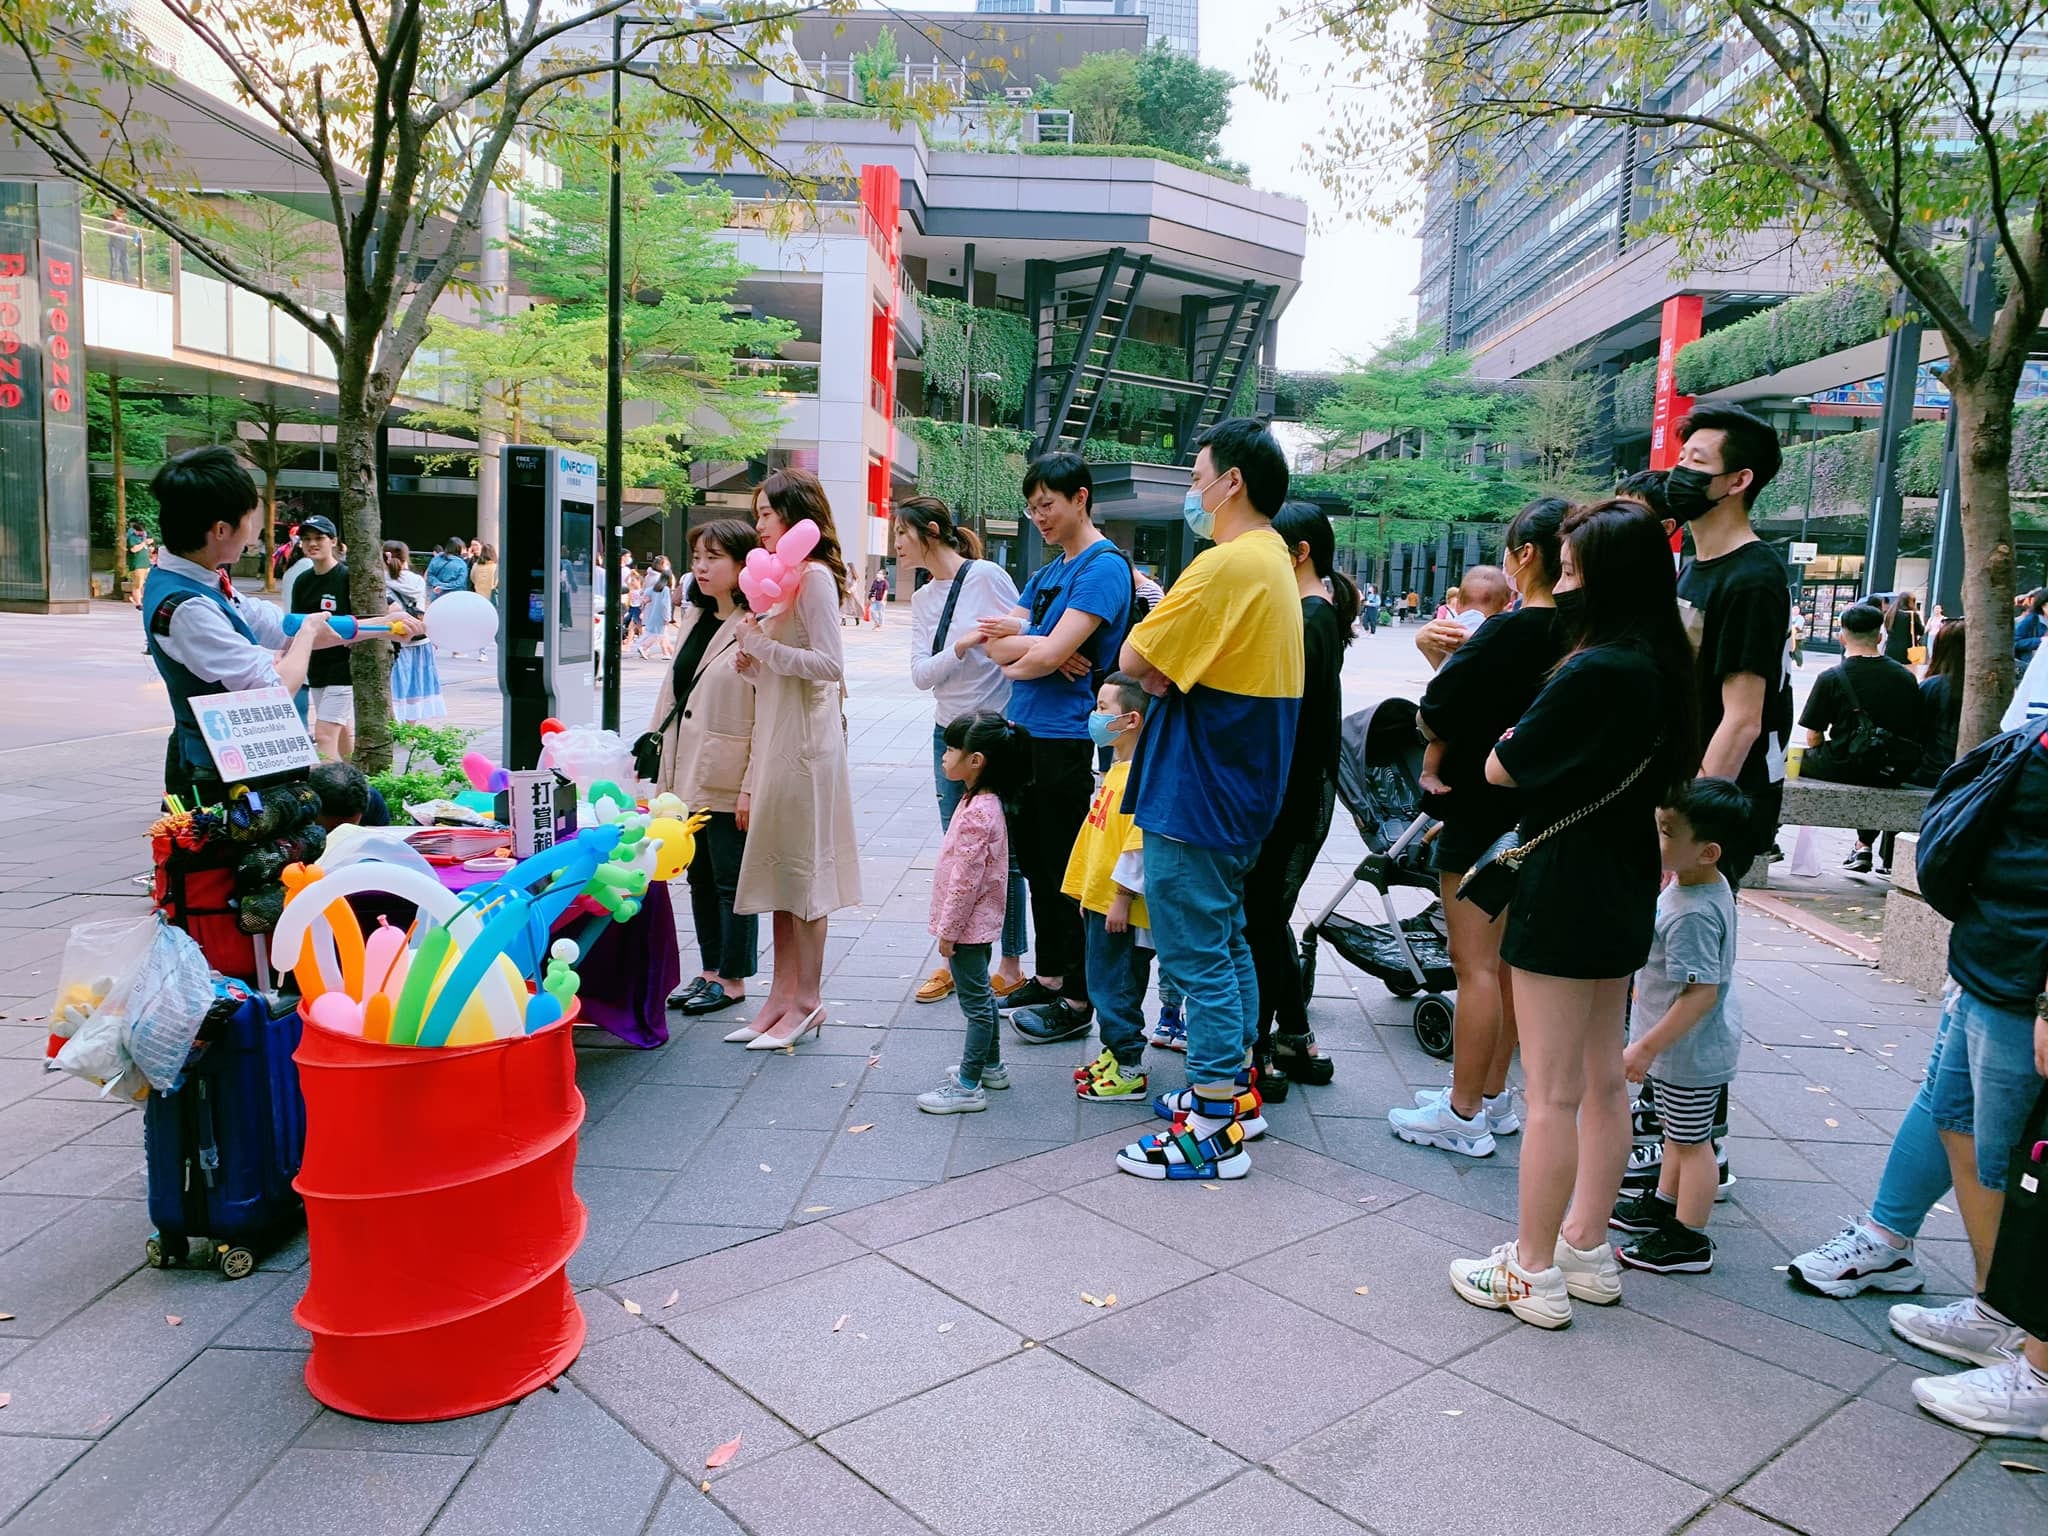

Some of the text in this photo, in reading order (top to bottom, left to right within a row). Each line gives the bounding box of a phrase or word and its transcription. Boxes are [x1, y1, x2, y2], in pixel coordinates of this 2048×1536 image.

[0, 253, 26, 408] Breeze
[48, 257, 72, 412] Breeze
[227, 704, 295, 725] 造型氣球柯男
[243, 722, 286, 736] BalloonMale
[241, 736, 310, 760] 造型氣球柯男
[531, 782, 552, 854] 打賞箱
